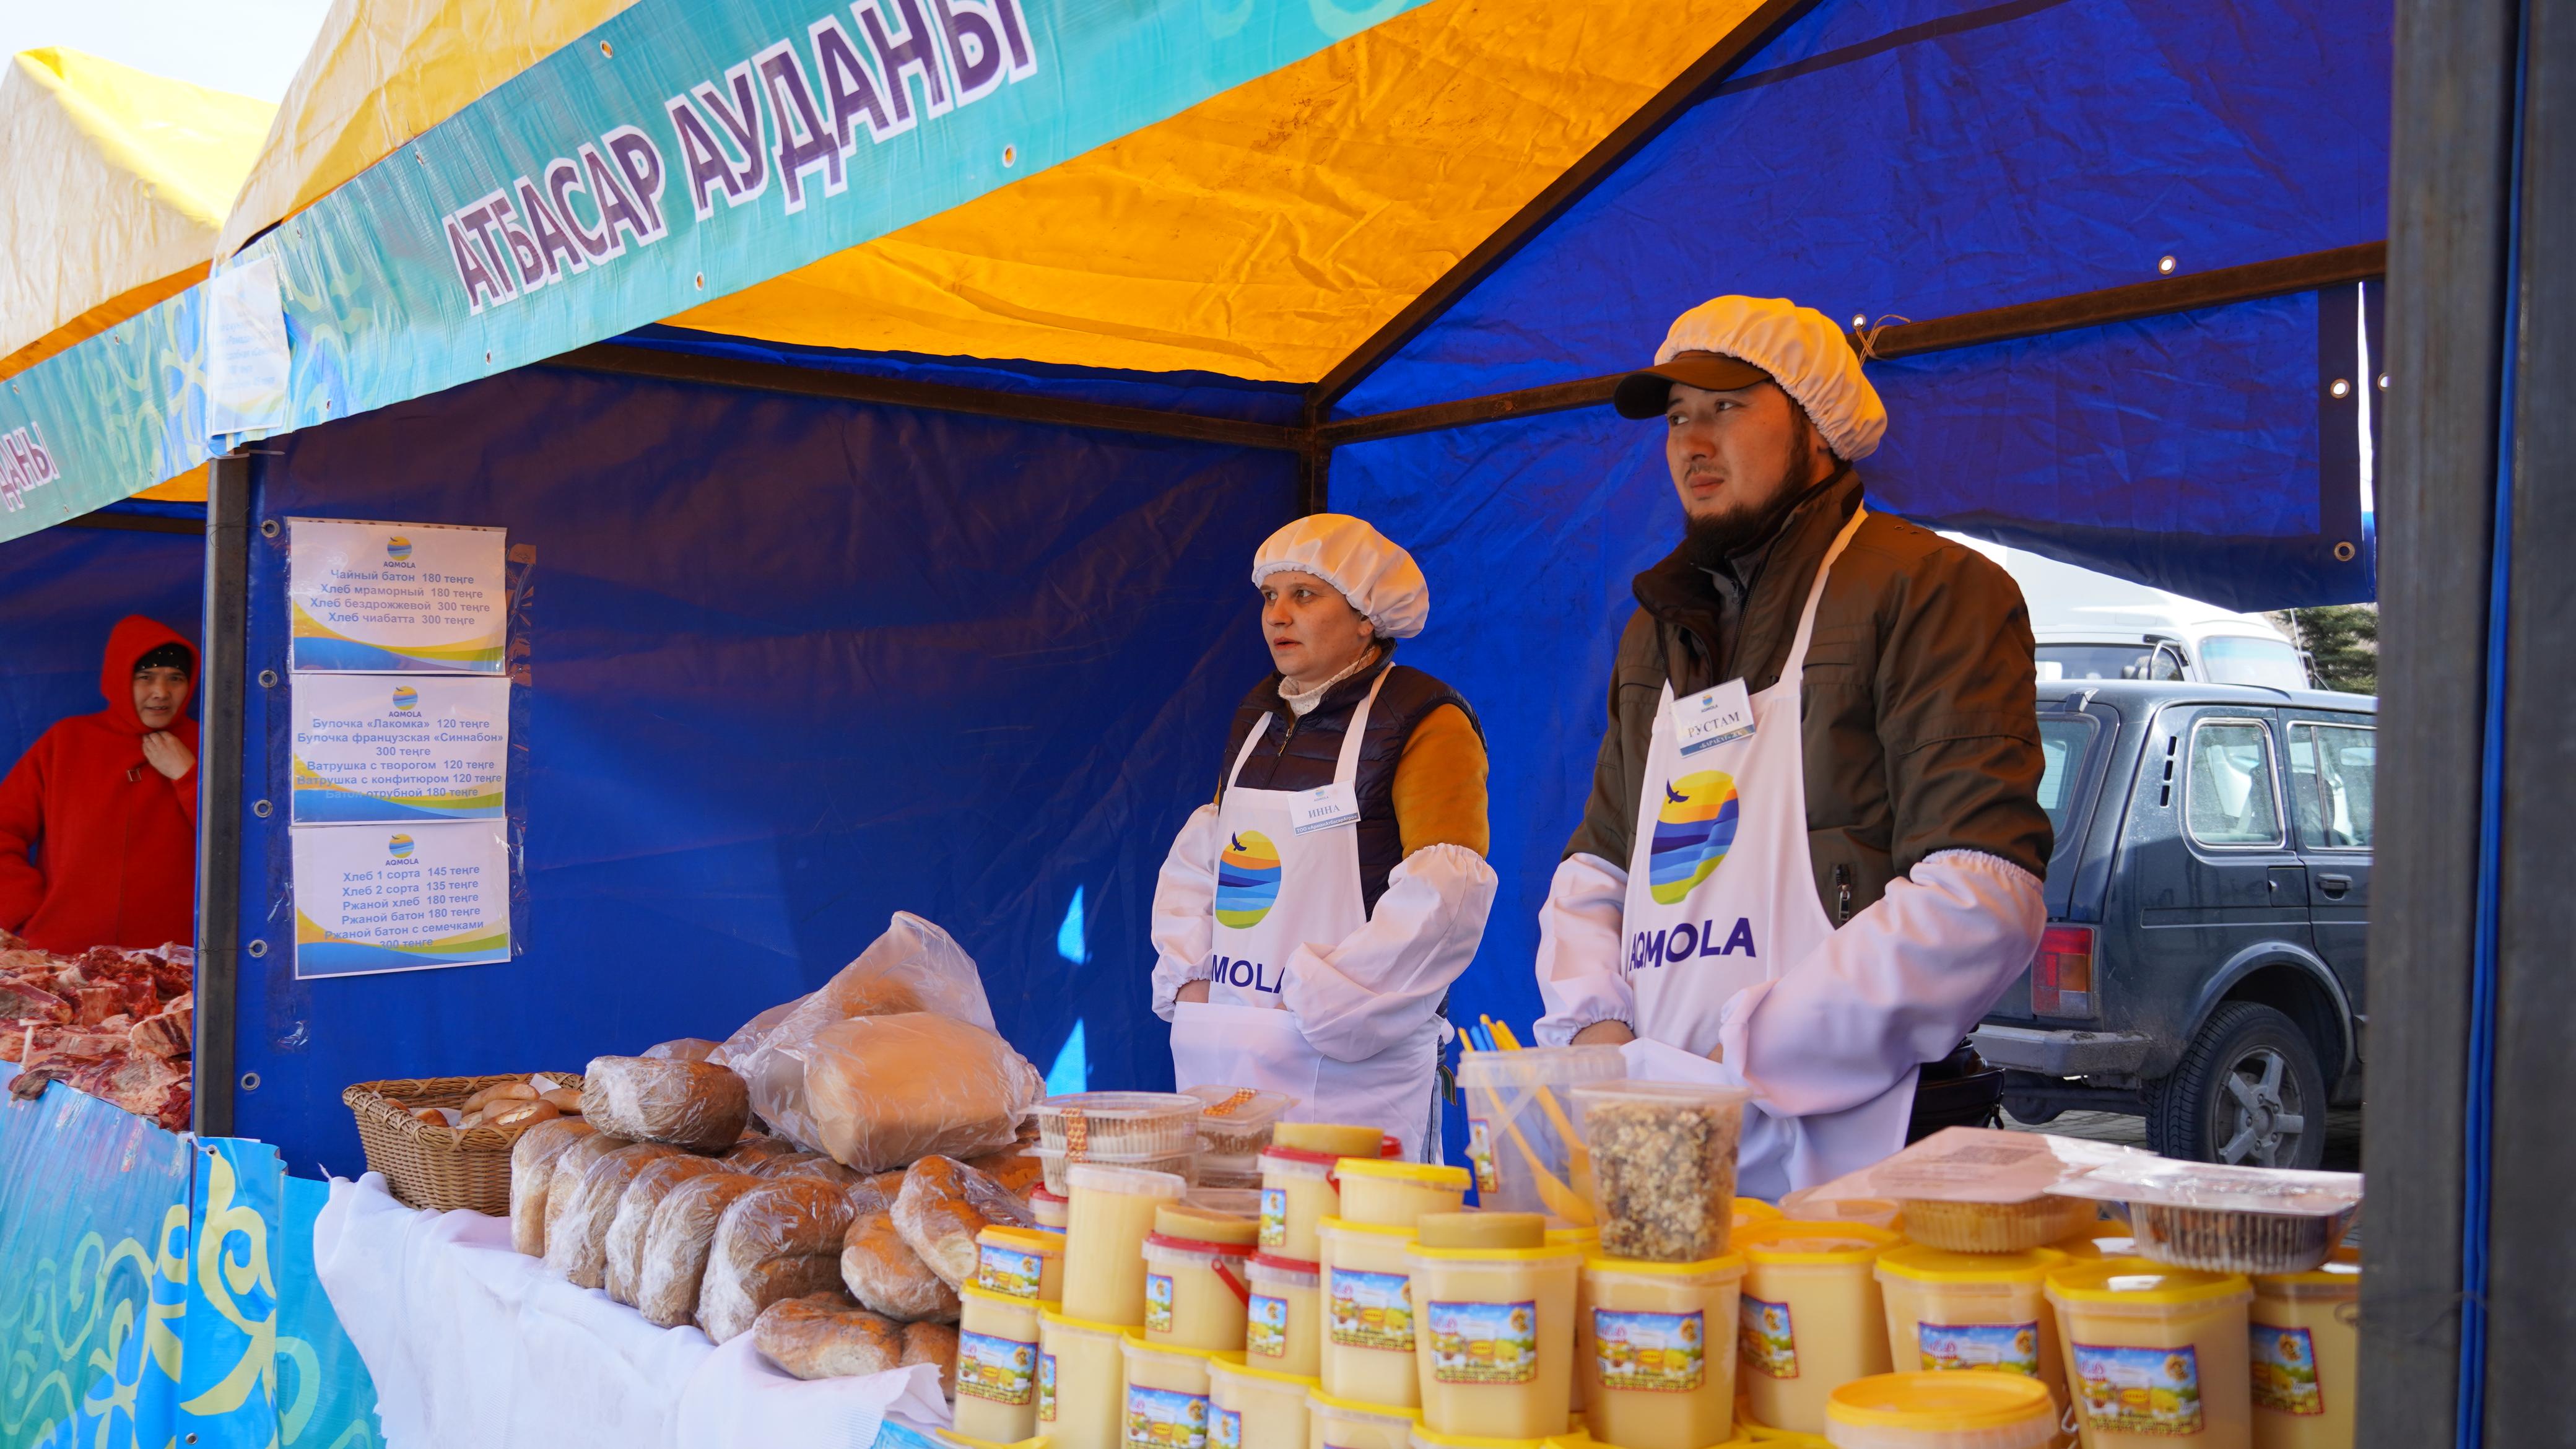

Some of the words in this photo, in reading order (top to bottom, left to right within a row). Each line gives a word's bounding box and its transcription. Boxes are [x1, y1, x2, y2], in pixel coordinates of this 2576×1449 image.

[442, 124, 669, 316] АТБАСАР
[665, 0, 1037, 221] АУДАНЫ
[331, 570, 378, 581] Чайный
[381, 572, 415, 582] батон
[422, 574, 441, 582] 180
[445, 575, 474, 585] теңге
[321, 585, 350, 594] Хлеб
[354, 587, 424, 598] мраморный
[431, 588, 450, 598] 180
[453, 590, 483, 599] теңге
[310, 598, 341, 607] Хлеб
[345, 600, 431, 612] бездрожжевой
[438, 602, 456, 611] 300
[461, 604, 490, 613] теңге
[329, 612, 359, 622] Хлеб
[363, 616, 415, 624] чиабатта
[422, 616, 441, 624] 300
[445, 617, 474, 625] теңге
[313, 718, 363, 729] Булочка
[367, 719, 430, 729] «Лакомка»
[437, 719, 456, 728] 120
[460, 720, 489, 729] теңге
[1688, 711, 1740, 738] РУСТАМ
[298, 733, 348, 744] Булочка
[352, 734, 430, 744] французская
[434, 733, 503, 742] «Синнабон»
[376, 747, 396, 756] 300
[399, 748, 430, 757] теңге
[307, 761, 366, 772] Ватрушка
[381, 762, 436, 772] творогом
[443, 760, 463, 768] 120
[466, 760, 494, 770] теңге
[297, 775, 357, 786] Ватрушка
[372, 775, 449, 785] конфитюром
[453, 773, 472, 783] 120
[475, 774, 502, 785] теңге
[326, 789, 362, 799] Батон
[367, 788, 422, 798] отрубной
[427, 788, 446, 797] 180
[450, 787, 478, 797] теңге
[1308, 805, 1340, 818] ИННА
[385, 858, 419, 866] AQMOLA
[343, 872, 373, 882] Хлеб
[378, 872, 383, 881] 1
[387, 870, 420, 881] сорта
[428, 868, 446, 877] 145
[450, 866, 480, 877] теңге
[342, 886, 372, 897] Хлеб
[376, 886, 382, 895] 2
[386, 885, 419, 895] сорта
[427, 881, 445, 891] 135
[449, 881, 479, 890] теңге
[342, 899, 389, 911] Ржаной
[393, 897, 420, 907] хлеб
[427, 895, 446, 905] 180
[450, 894, 479, 904] теңге
[342, 913, 388, 925] Ржаной
[391, 912, 424, 921] батон
[429, 908, 447, 918] 180
[451, 907, 481, 918] теңге
[324, 928, 371, 940] Ржаной
[375, 926, 408, 936] батон
[422, 921, 483, 933] семечками
[380, 940, 399, 949] 300
[402, 939, 433, 949] теңге
[1629, 918, 1756, 972] AQMOLA
